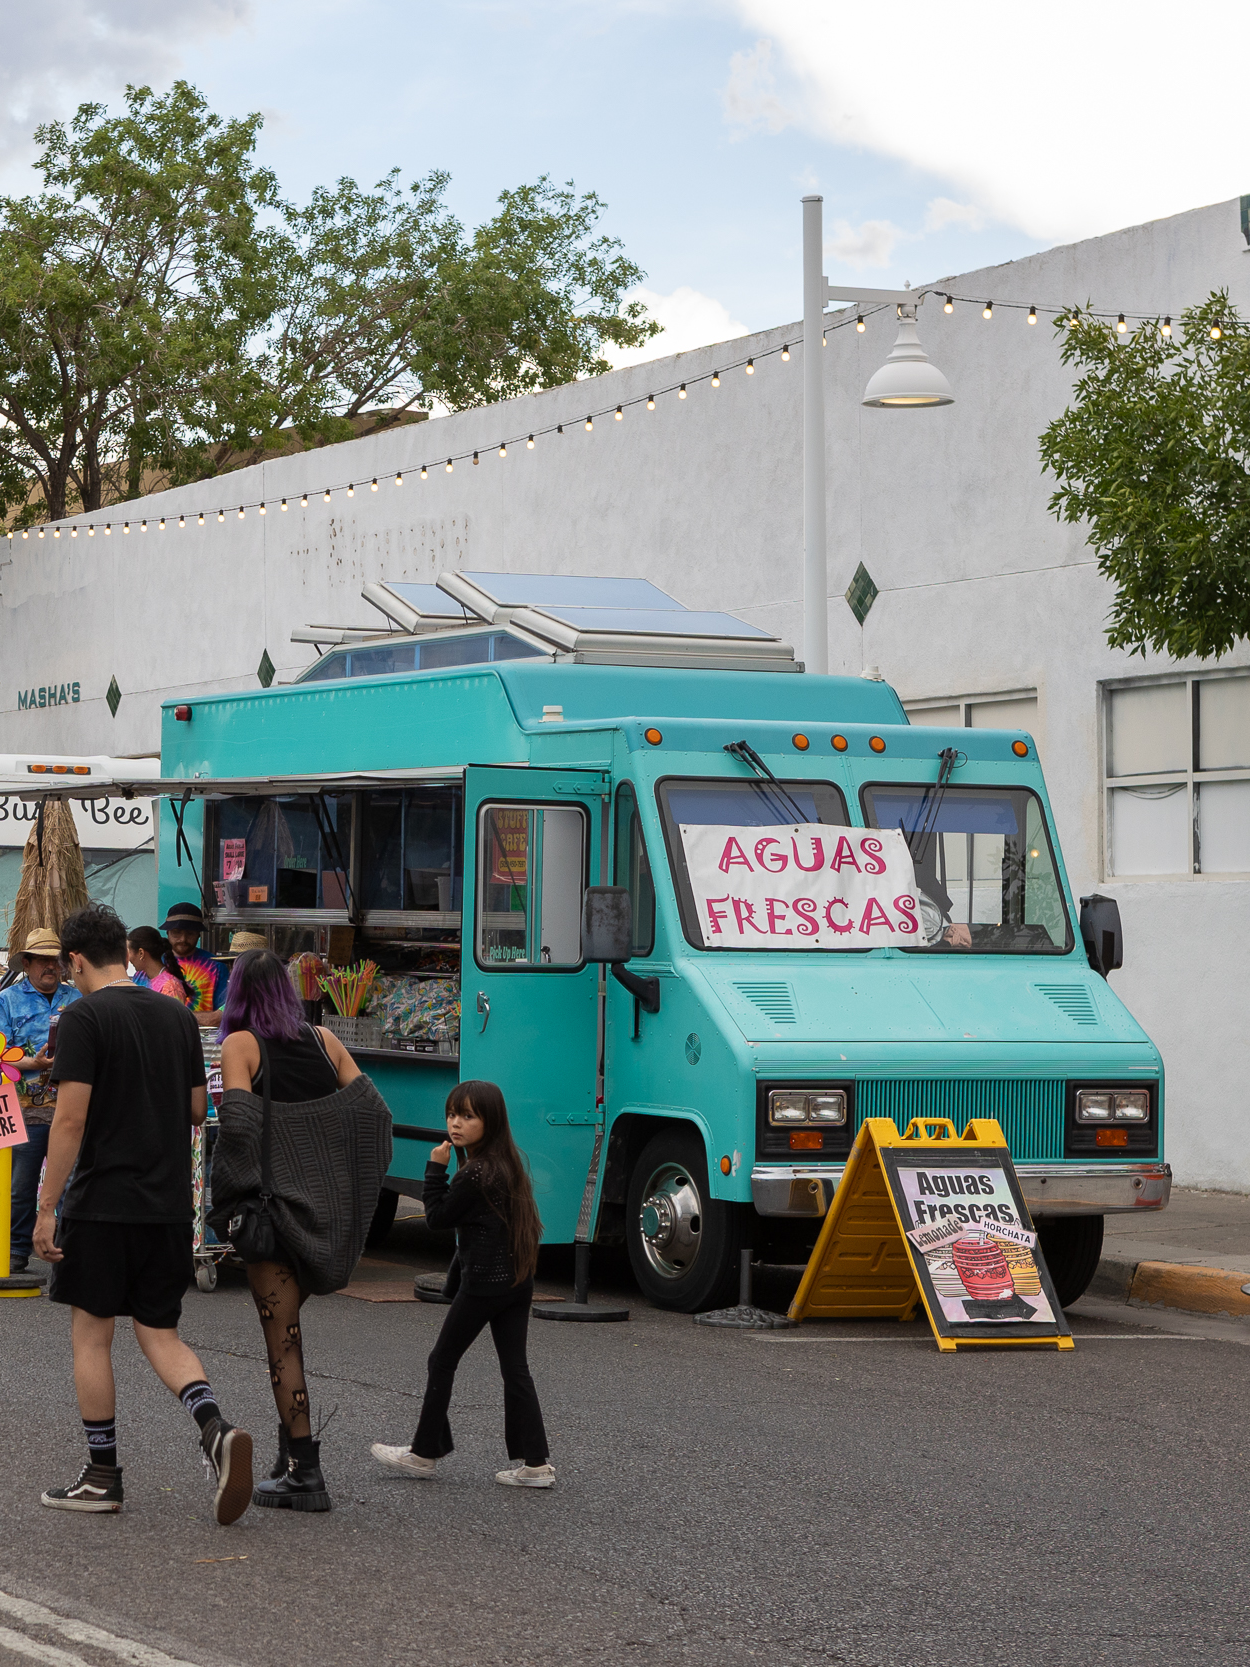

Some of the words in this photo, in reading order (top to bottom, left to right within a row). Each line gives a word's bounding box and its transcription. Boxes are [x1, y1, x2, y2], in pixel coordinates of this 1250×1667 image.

[18, 681, 81, 710] MASHA'S
[81, 797, 150, 826] Bee
[718, 836, 887, 875] AGUAS
[706, 893, 919, 936] FRESCAS
[502, 946, 511, 963] Up
[511, 946, 526, 959] Here
[916, 1171, 995, 1198] Aguas
[913, 1200, 1016, 1225] Frescas
[910, 1218, 964, 1248] Lemonade
[983, 1220, 1031, 1244] HORCHATA
